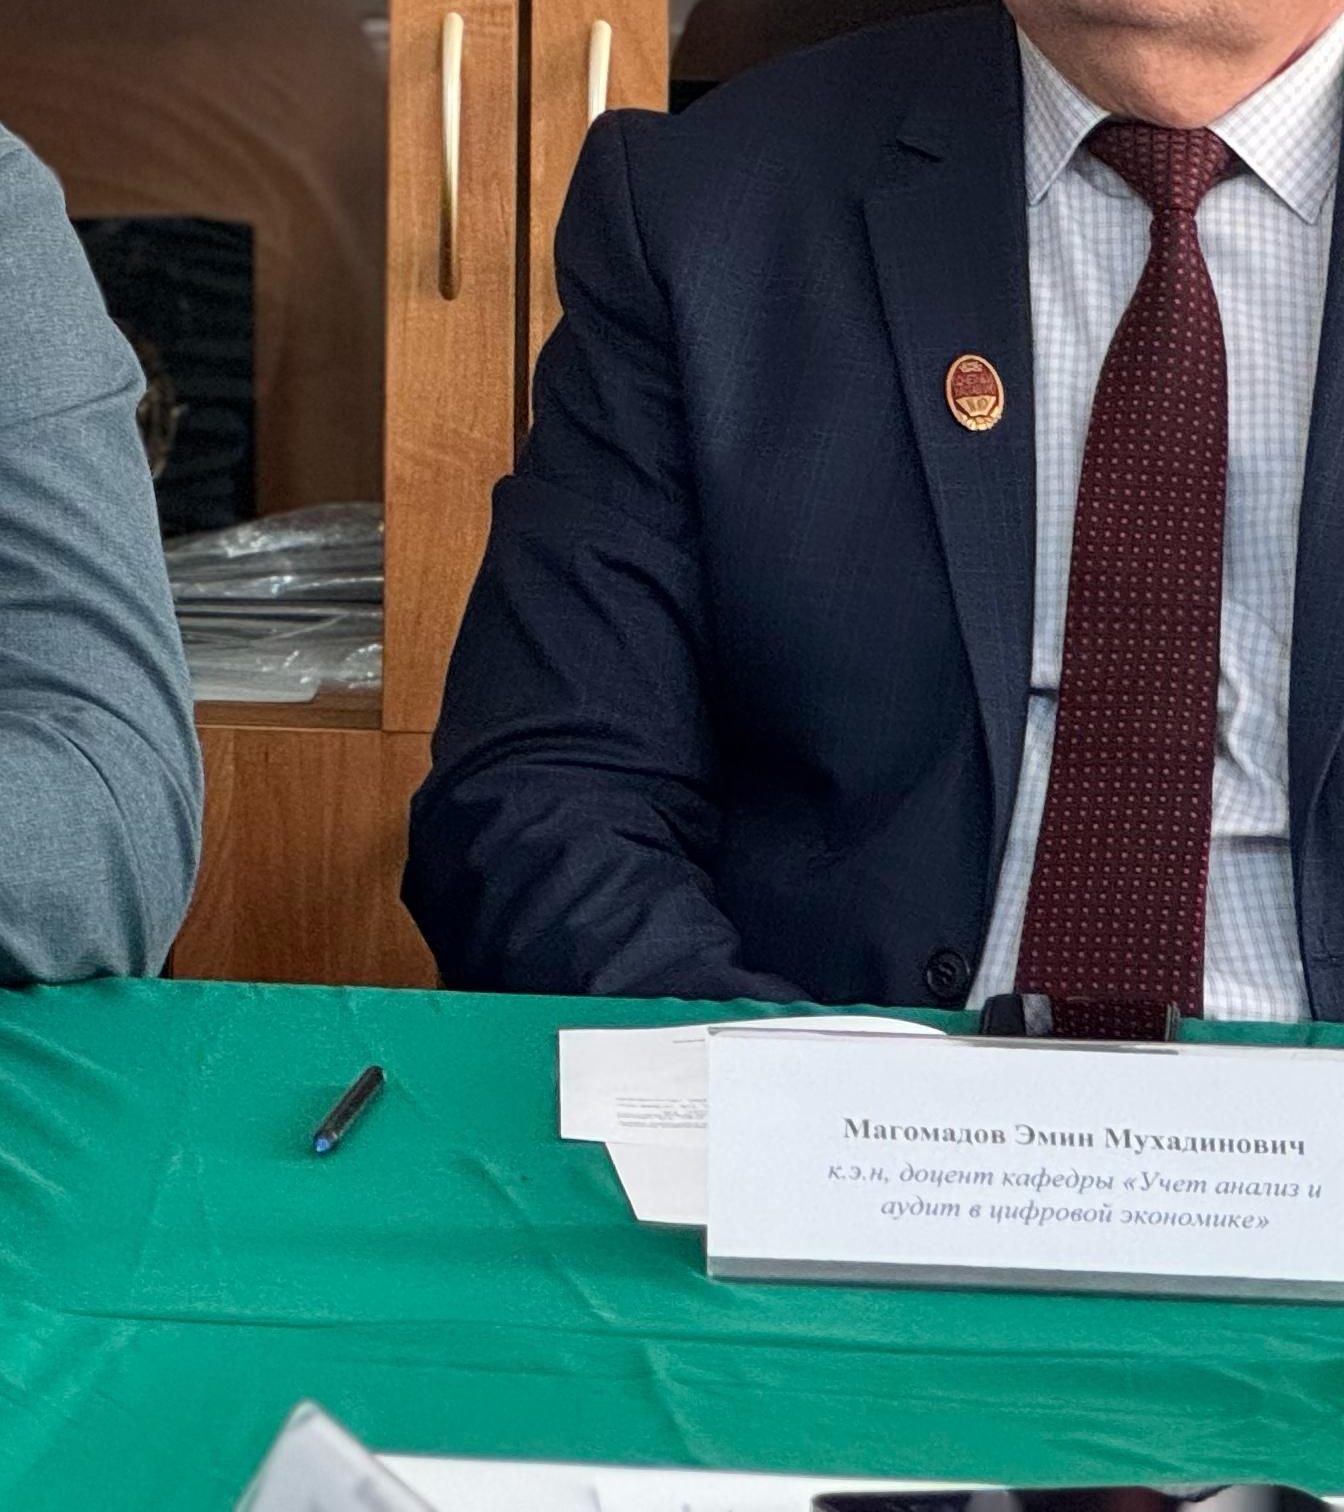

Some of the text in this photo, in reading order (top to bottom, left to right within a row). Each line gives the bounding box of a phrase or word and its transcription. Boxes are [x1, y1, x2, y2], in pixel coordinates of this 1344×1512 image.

[843, 1117, 1305, 1156] Магомадов Эмин Мухадинович
[899, 1161, 994, 1187] доцент
[1001, 1167, 1114, 1195] кафедры
[1122, 1170, 1207, 1195] «Учет
[1214, 1179, 1300, 1198] анализ
[1307, 1184, 1322, 1200] и
[880, 1195, 1270, 1230] аудит в цифровой экономике»
